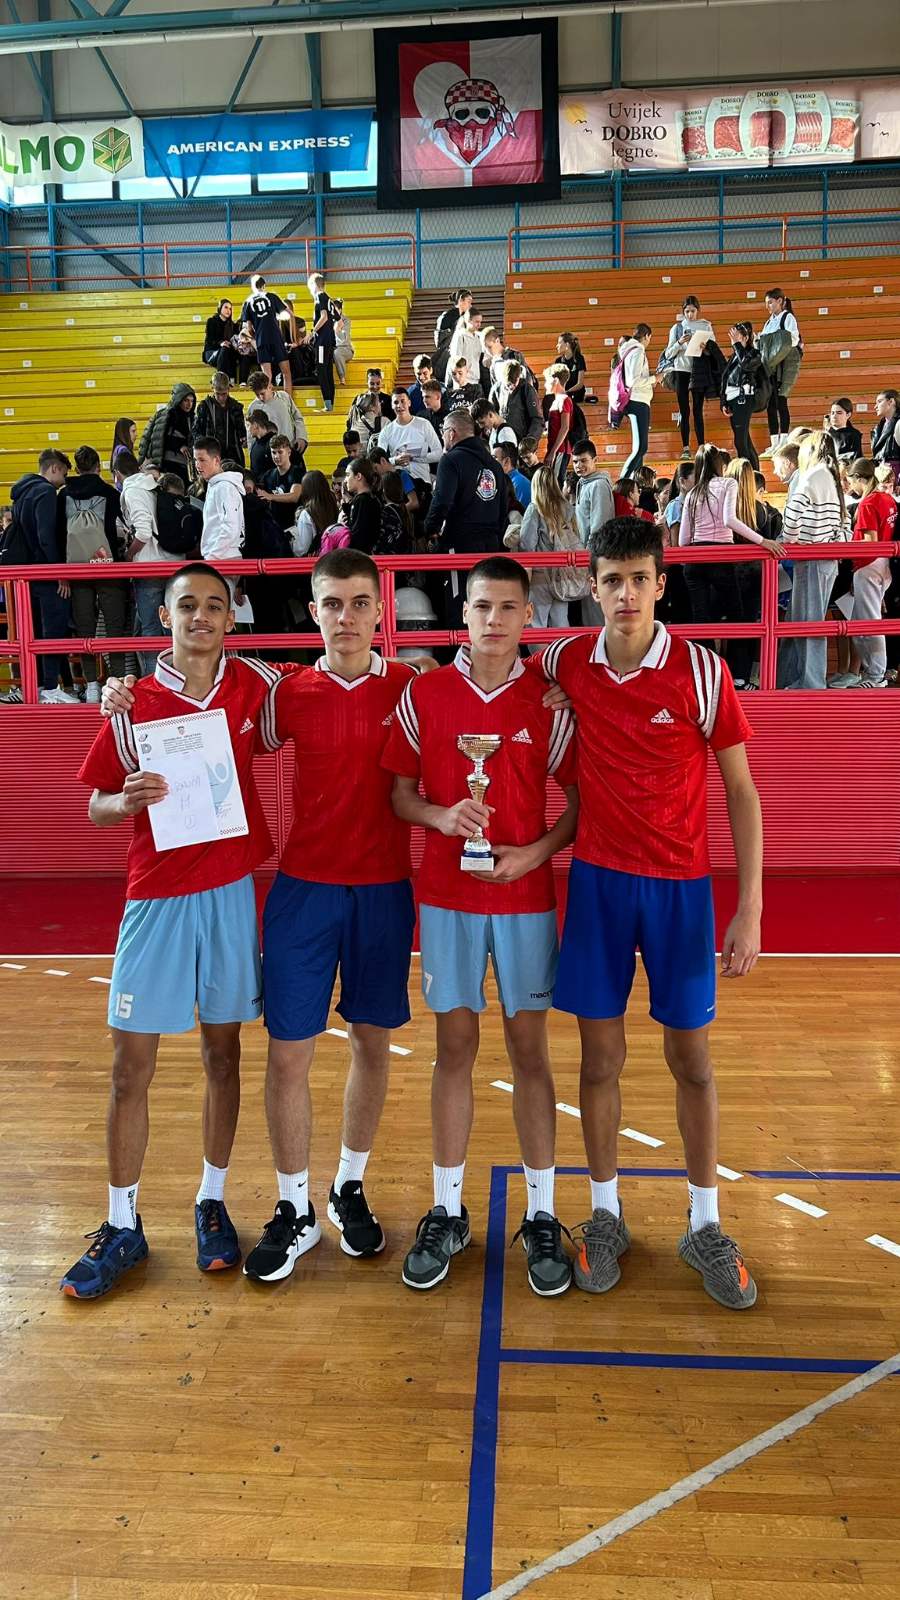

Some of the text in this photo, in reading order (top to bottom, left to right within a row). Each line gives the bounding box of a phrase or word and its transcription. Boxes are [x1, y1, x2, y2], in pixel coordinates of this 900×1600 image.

[608, 101, 662, 123] Uvijek
[602, 125, 667, 141] DOBRO
[0, 135, 86, 174] LMO
[167, 136, 351, 155] AMERICAN EXPRESS
[611, 142, 658, 162] legne.
[256, 300, 266, 311] 11
[512, 736, 532, 744] adidas
[530, 990, 552, 999] macr
[115, 992, 134, 1019] 15
